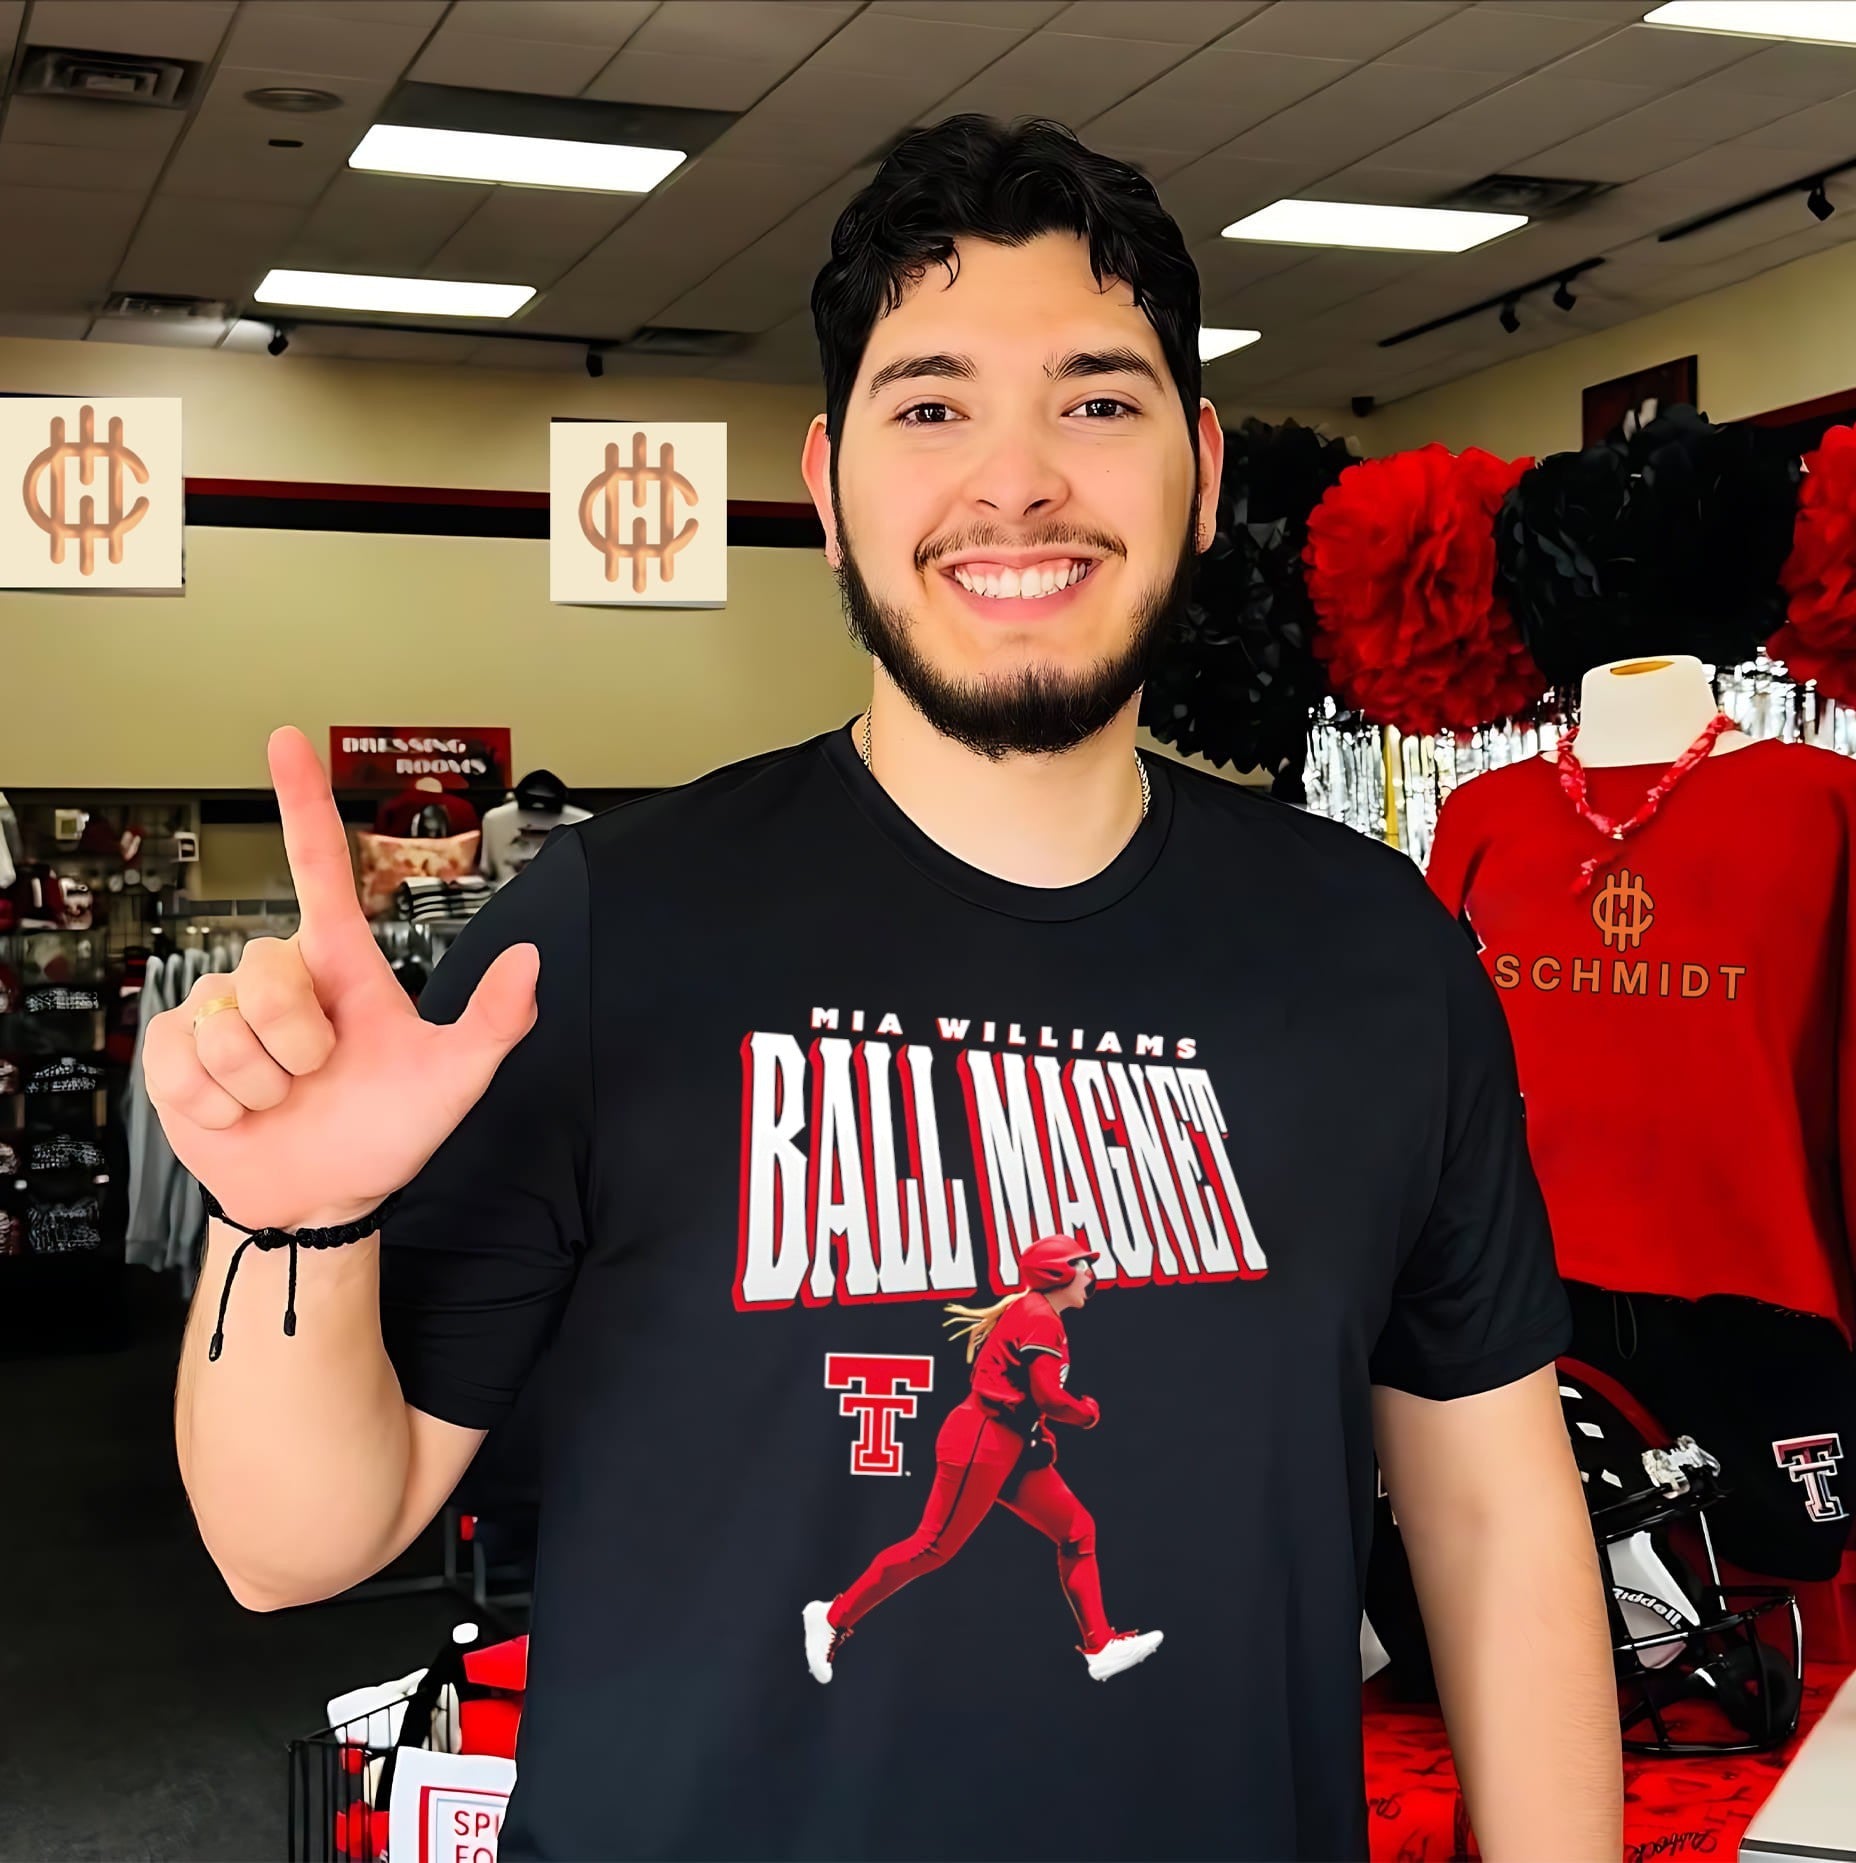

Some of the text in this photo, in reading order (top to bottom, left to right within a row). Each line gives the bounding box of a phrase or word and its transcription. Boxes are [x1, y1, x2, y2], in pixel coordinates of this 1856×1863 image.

[342, 737, 466, 753] DRESSING
[396, 758, 487, 774] ROOMS
[1494, 954, 1746, 1000] SCHMIDT
[810, 1007, 1197, 1060] MIA WILLIAMS
[732, 1031, 1268, 1311] BALL MAGNET
